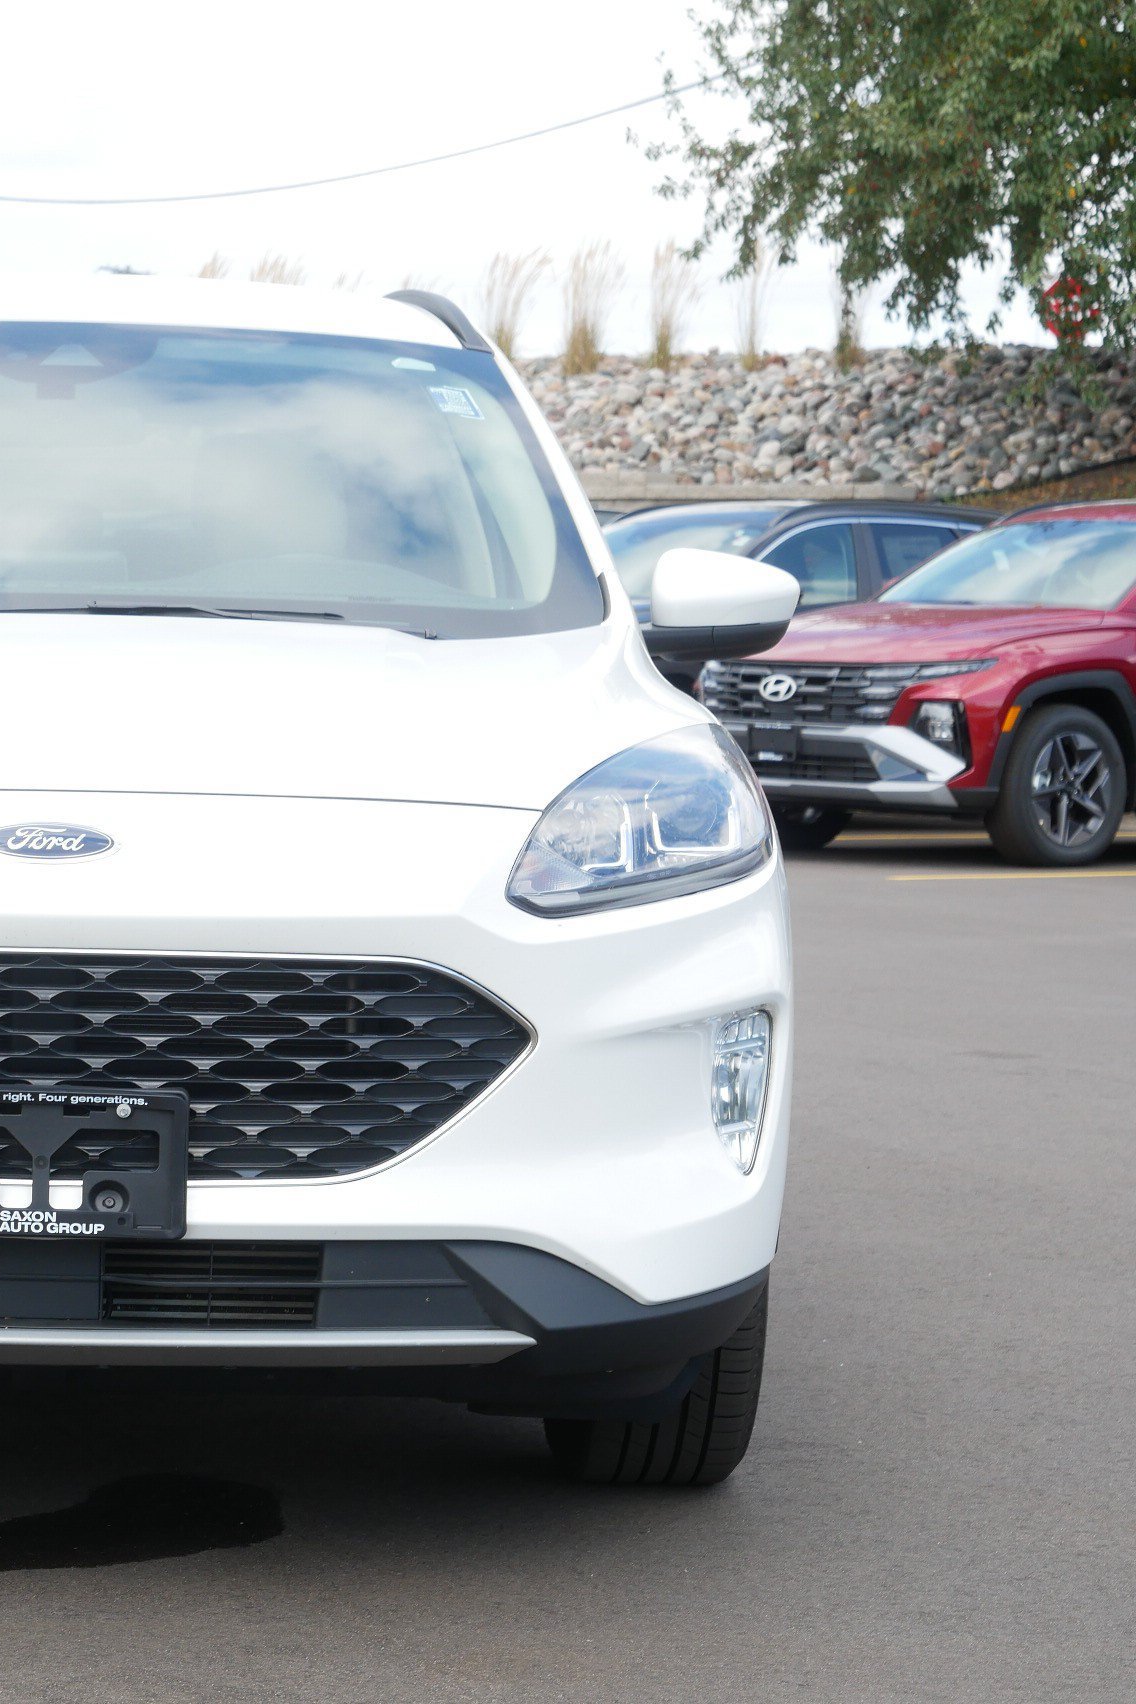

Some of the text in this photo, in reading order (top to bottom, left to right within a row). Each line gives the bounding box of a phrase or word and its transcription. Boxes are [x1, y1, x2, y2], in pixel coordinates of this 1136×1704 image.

[7, 826, 86, 851] Ford
[2, 1092, 35, 1103] right.
[38, 1093, 68, 1103] Four
[70, 1095, 149, 1106] generations.
[0, 1210, 57, 1223] SAXON
[45, 1222, 106, 1235] GROUP
